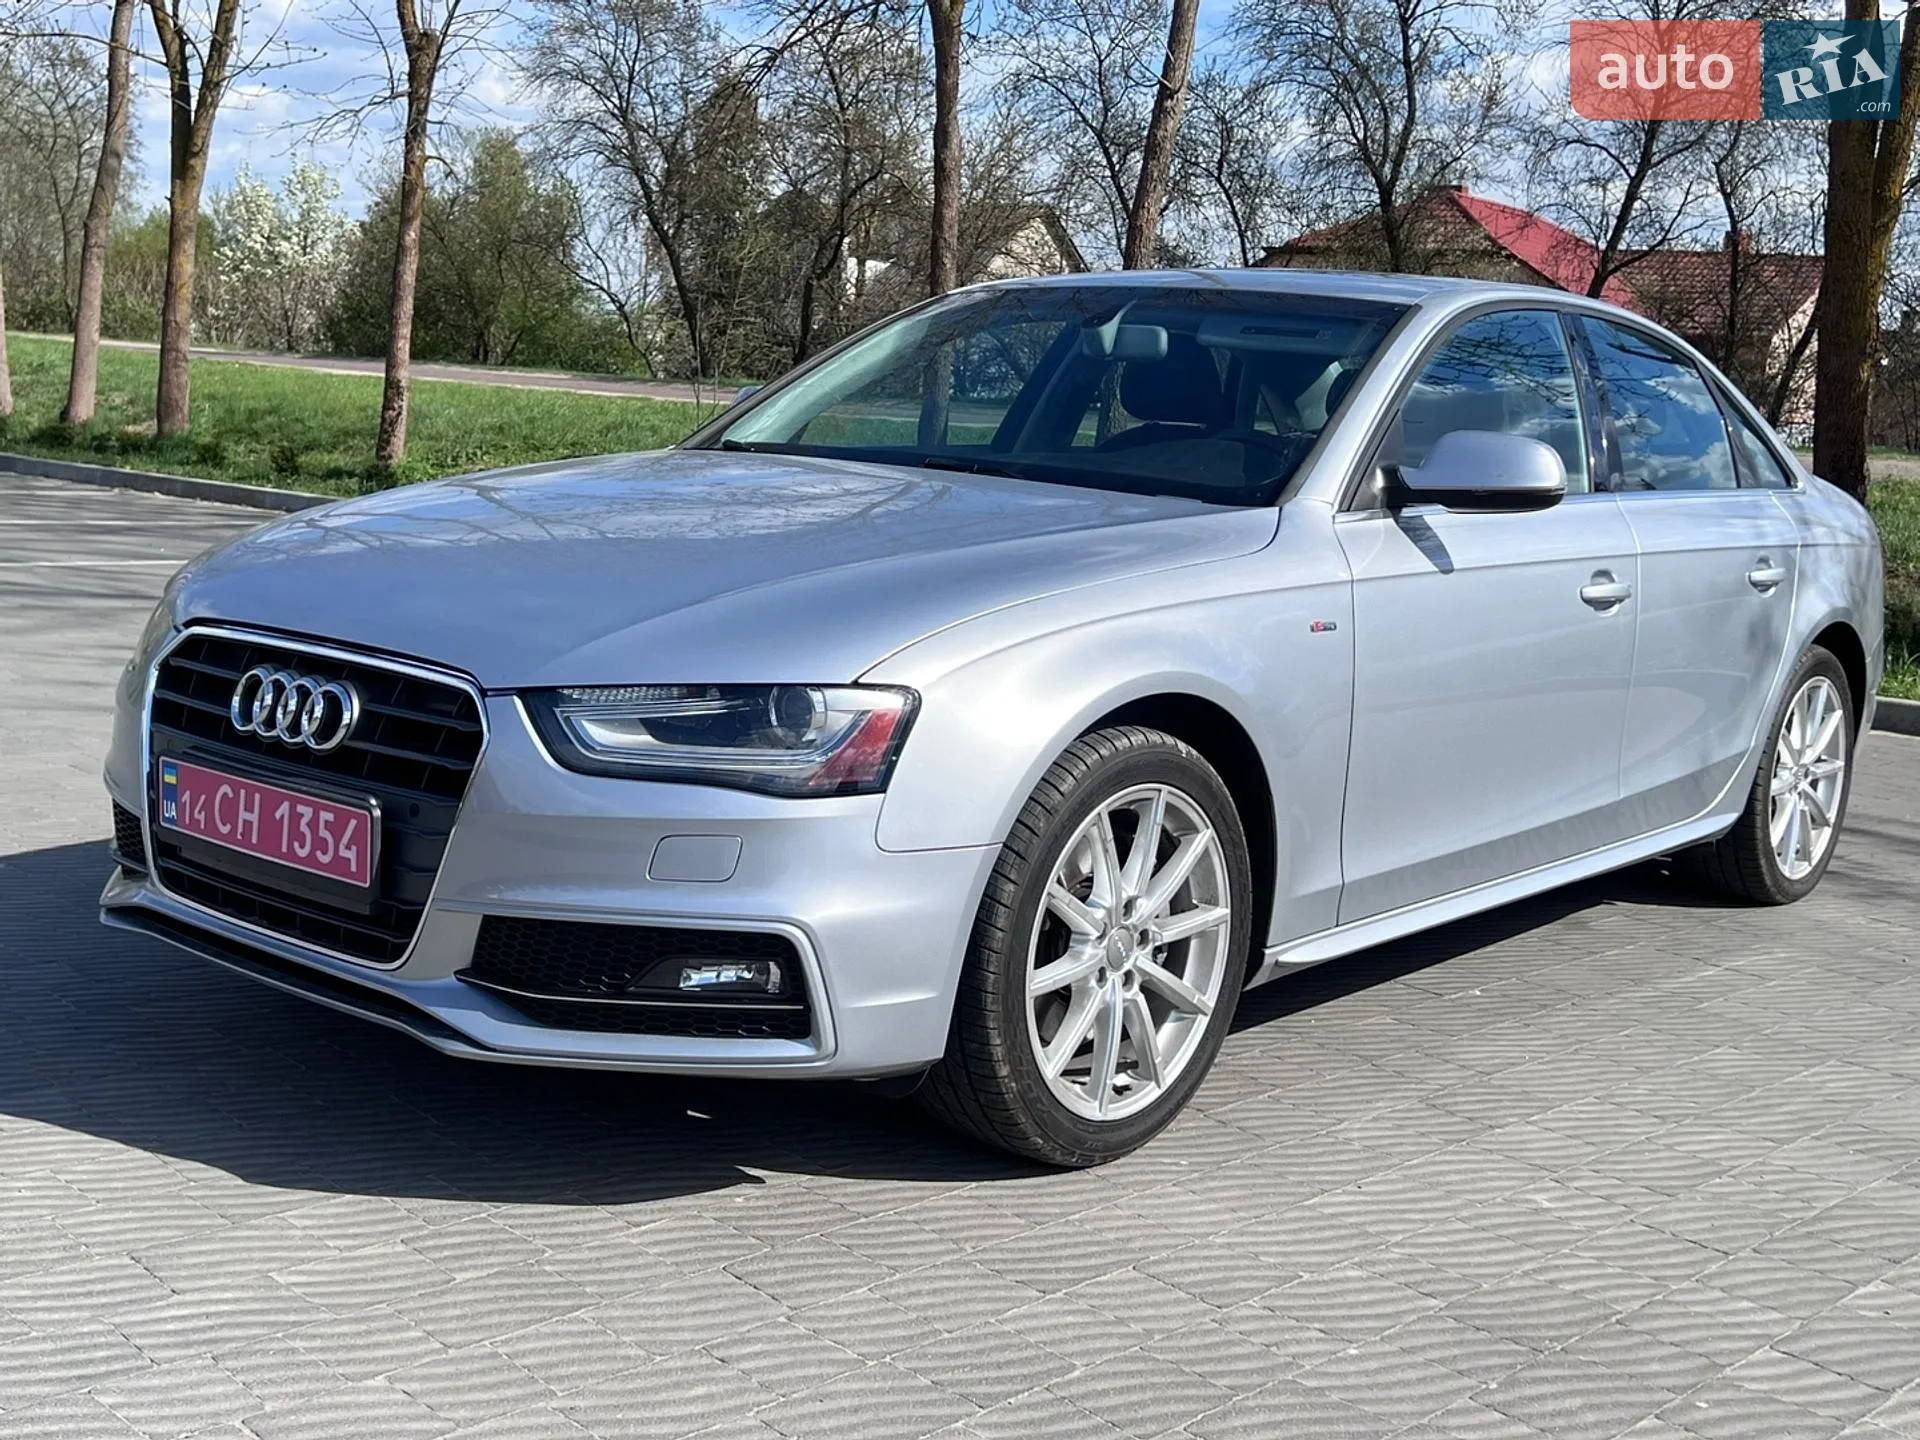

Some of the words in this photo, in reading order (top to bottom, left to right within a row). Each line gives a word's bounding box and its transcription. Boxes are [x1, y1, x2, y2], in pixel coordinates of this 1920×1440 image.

[163, 799, 178, 820] UA
[181, 790, 206, 830] 14
[275, 800, 358, 873] 1354
